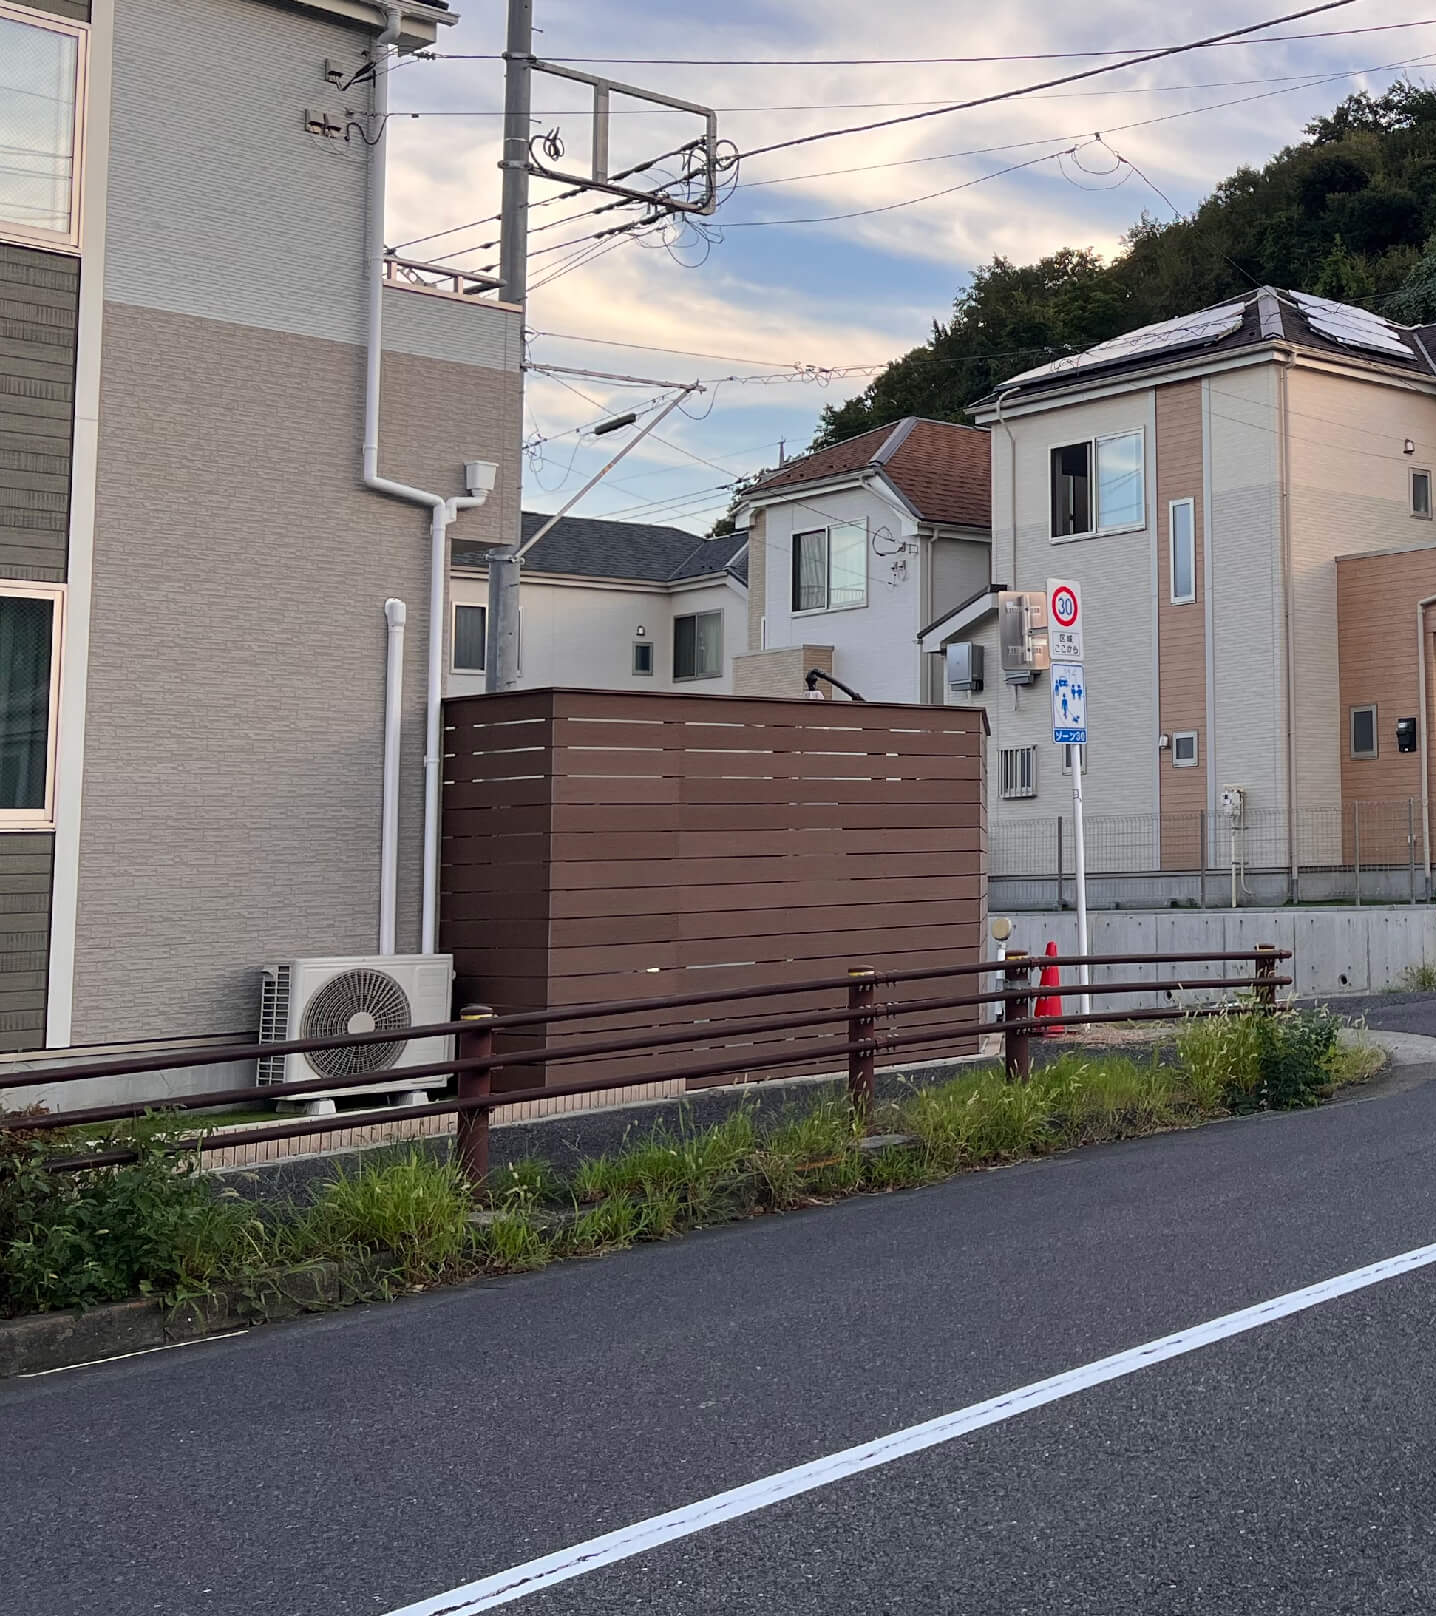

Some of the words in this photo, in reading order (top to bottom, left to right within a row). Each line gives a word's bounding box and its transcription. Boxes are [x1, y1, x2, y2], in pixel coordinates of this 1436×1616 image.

[1058, 597, 1073, 616] 30
[1059, 633, 1073, 643] 区域
[1054, 644, 1079, 655] ここから
